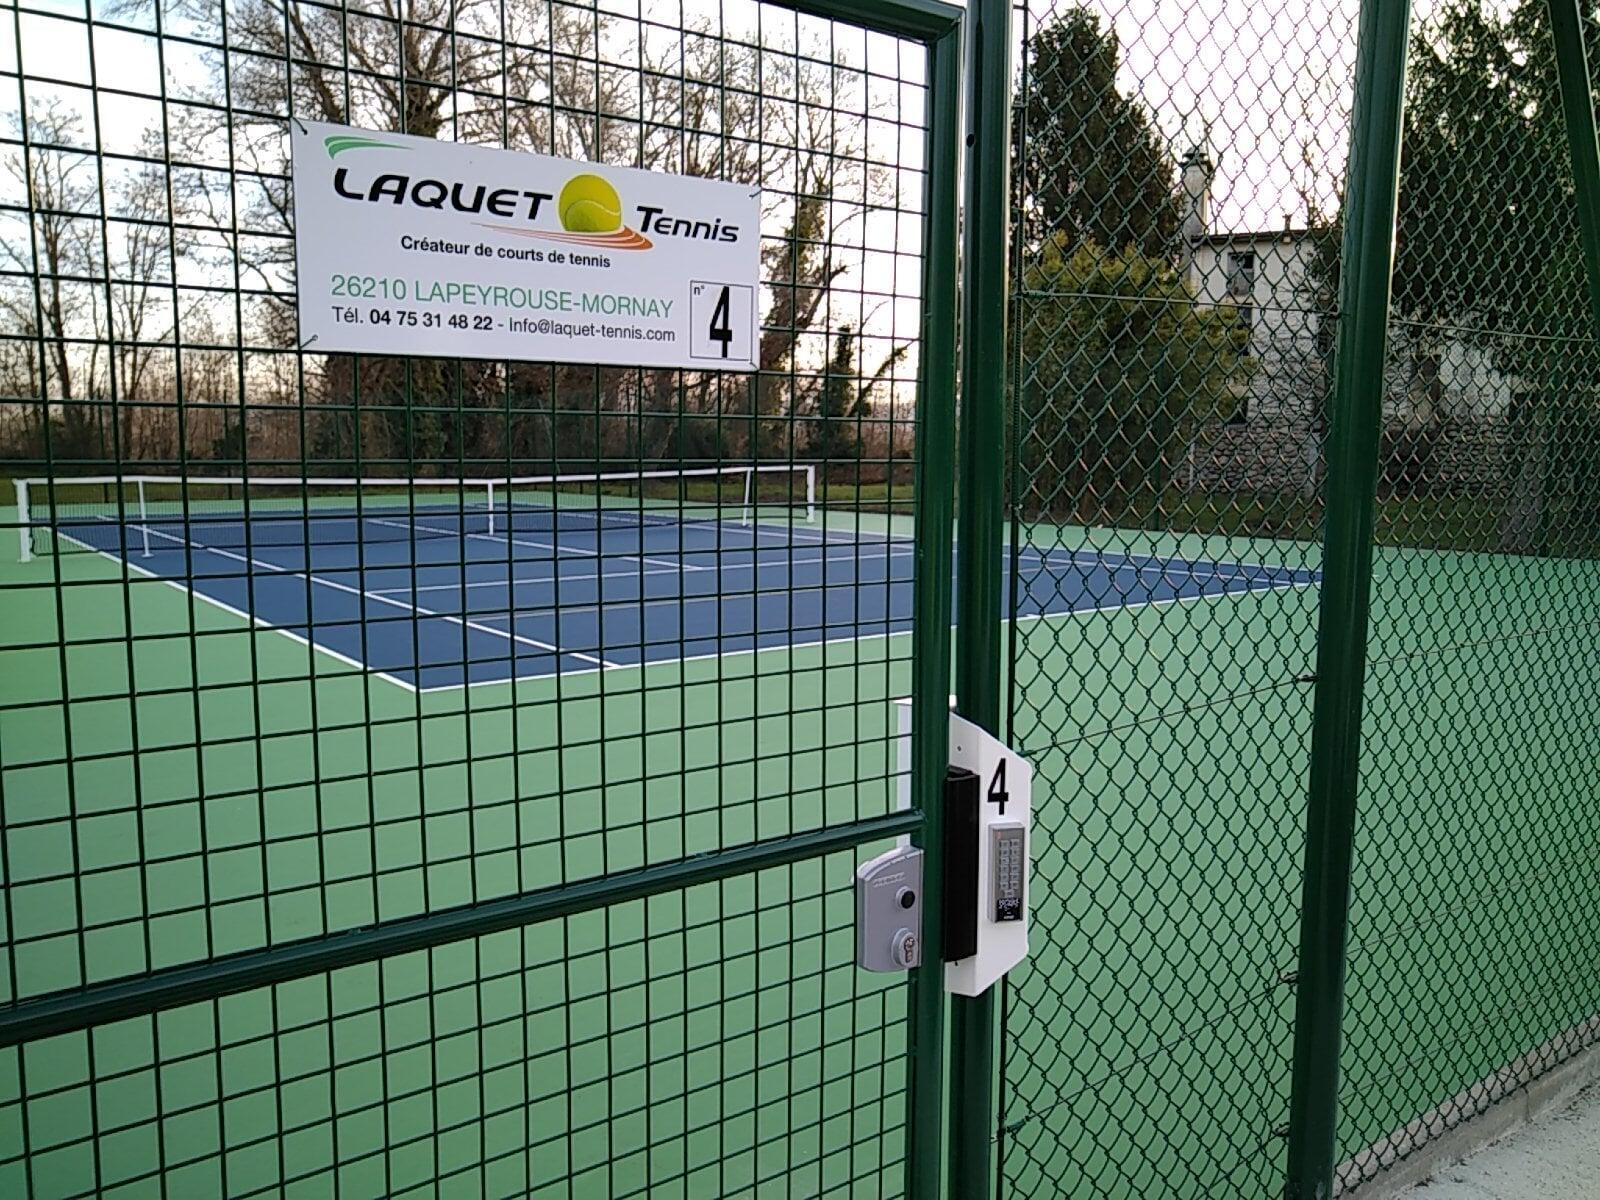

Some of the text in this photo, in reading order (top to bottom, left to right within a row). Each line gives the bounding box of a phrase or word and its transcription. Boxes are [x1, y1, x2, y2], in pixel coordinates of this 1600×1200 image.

[334, 168, 739, 243] LAQUET Tennis
[401, 235, 611, 268] Créateur de courts de tennis
[331, 274, 673, 318] 26210 LAPEYROUSE-MORNAY
[332, 306, 364, 324] Tél.
[369, 308, 391, 326] 04
[396, 310, 418, 327] 75
[422, 312, 442, 328] 31
[448, 314, 469, 330] 48
[473, 315, 493, 331] 22
[509, 317, 676, 342] Info@laquet-tennis.com
[709, 286, 733, 359] 4
[986, 757, 1009, 816] 4
